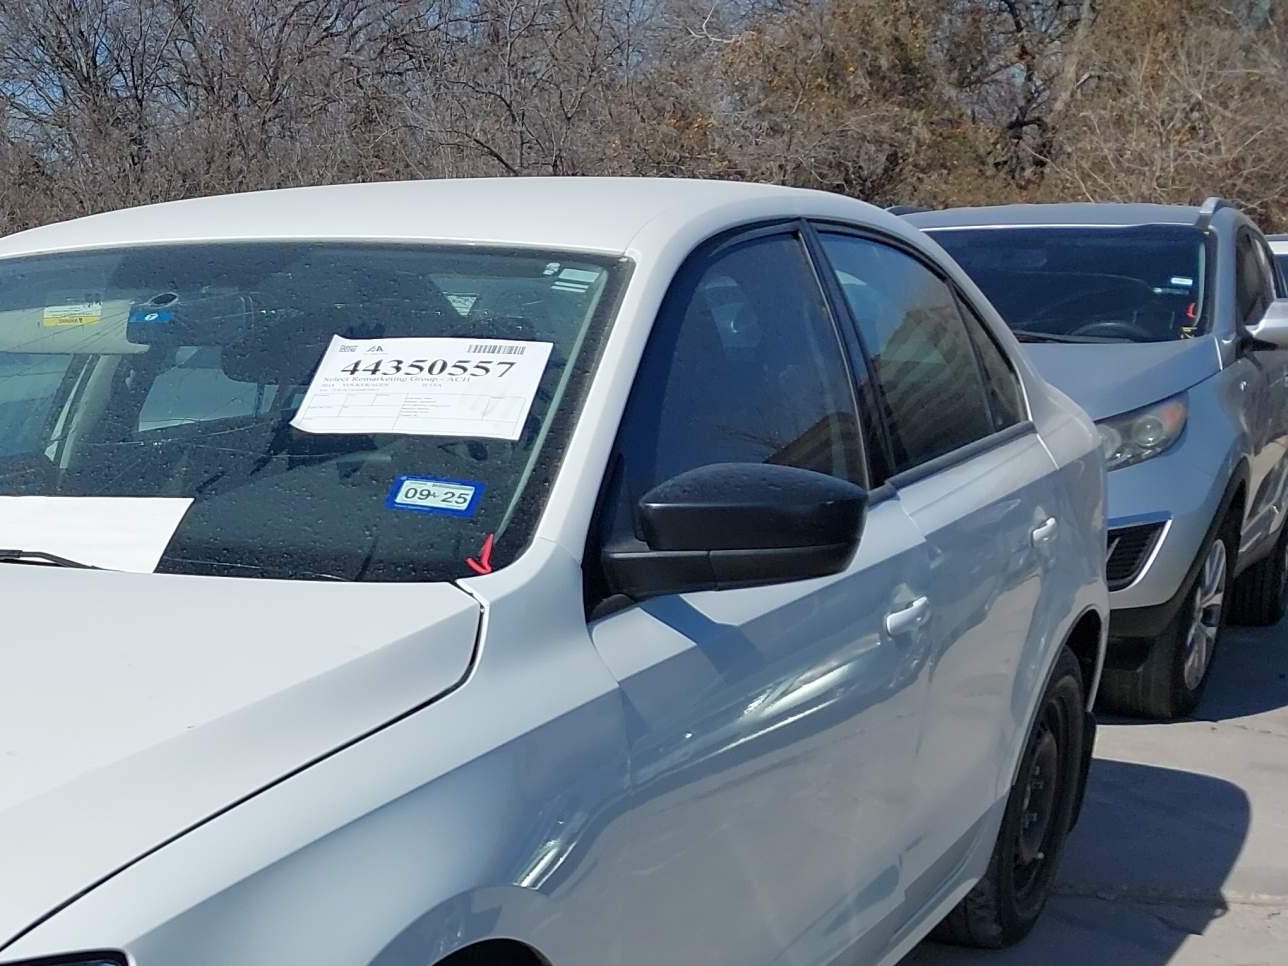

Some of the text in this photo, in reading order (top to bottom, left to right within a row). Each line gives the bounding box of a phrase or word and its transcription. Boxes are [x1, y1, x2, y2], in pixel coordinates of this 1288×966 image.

[341, 359, 517, 378] 44350557
[404, 487, 470, 504] 09 25
